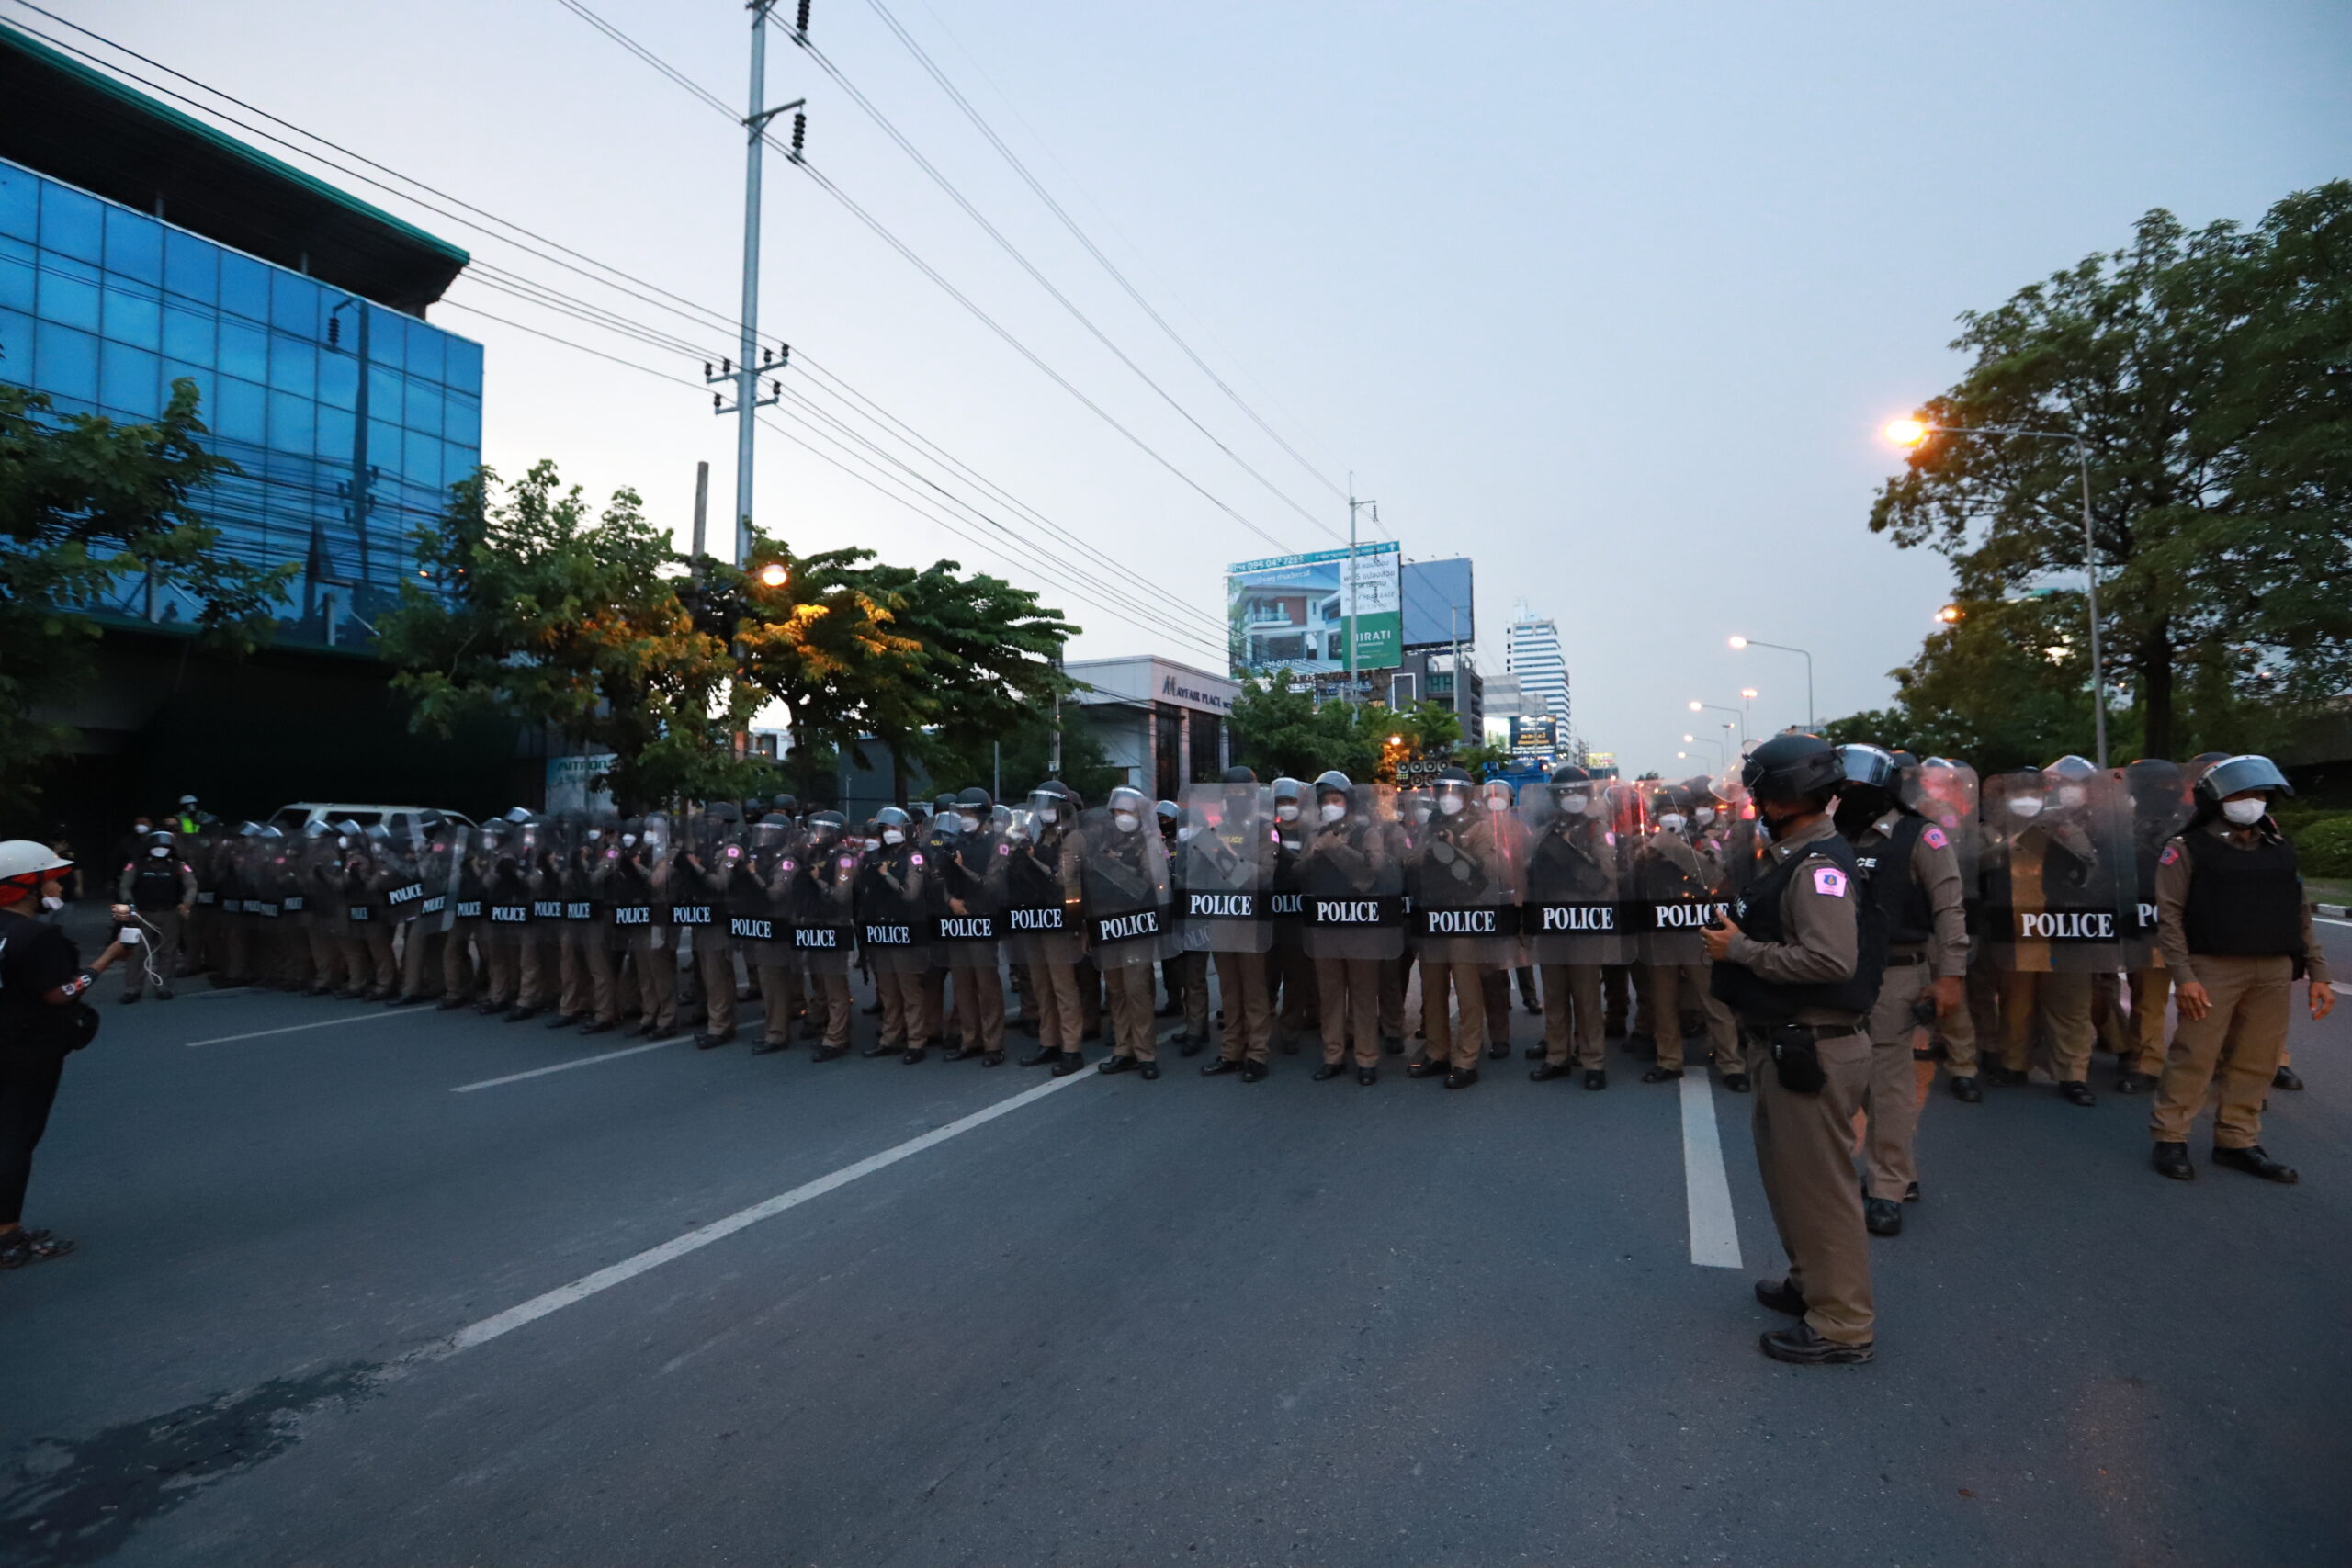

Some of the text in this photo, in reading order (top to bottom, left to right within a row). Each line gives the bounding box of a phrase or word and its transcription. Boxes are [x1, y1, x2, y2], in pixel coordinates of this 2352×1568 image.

[1162, 675, 1200, 702] MAYFAIR
[1202, 694, 1221, 707] PLACE
[389, 883, 424, 905] POLICE
[422, 896, 446, 916] POLICE
[457, 900, 481, 917] POLICE
[492, 906, 526, 922] POLICE
[534, 901, 561, 917] POLICE
[567, 902, 591, 919] POLICE
[673, 906, 711, 923] POLICE
[1190, 894, 1252, 916] POLICE
[1317, 901, 1380, 922] POLICE
[616, 907, 650, 924] POLICE
[1010, 908, 1063, 929] POLICE
[1428, 910, 1496, 932] POLICE
[1543, 907, 1614, 930] POLICE
[2020, 912, 2114, 938] POLICE
[731, 918, 772, 939] POLICE
[866, 925, 910, 944] POLICE
[940, 918, 992, 937] POLICE
[1099, 911, 1159, 941] POLICE
[796, 929, 836, 947] POLICE
